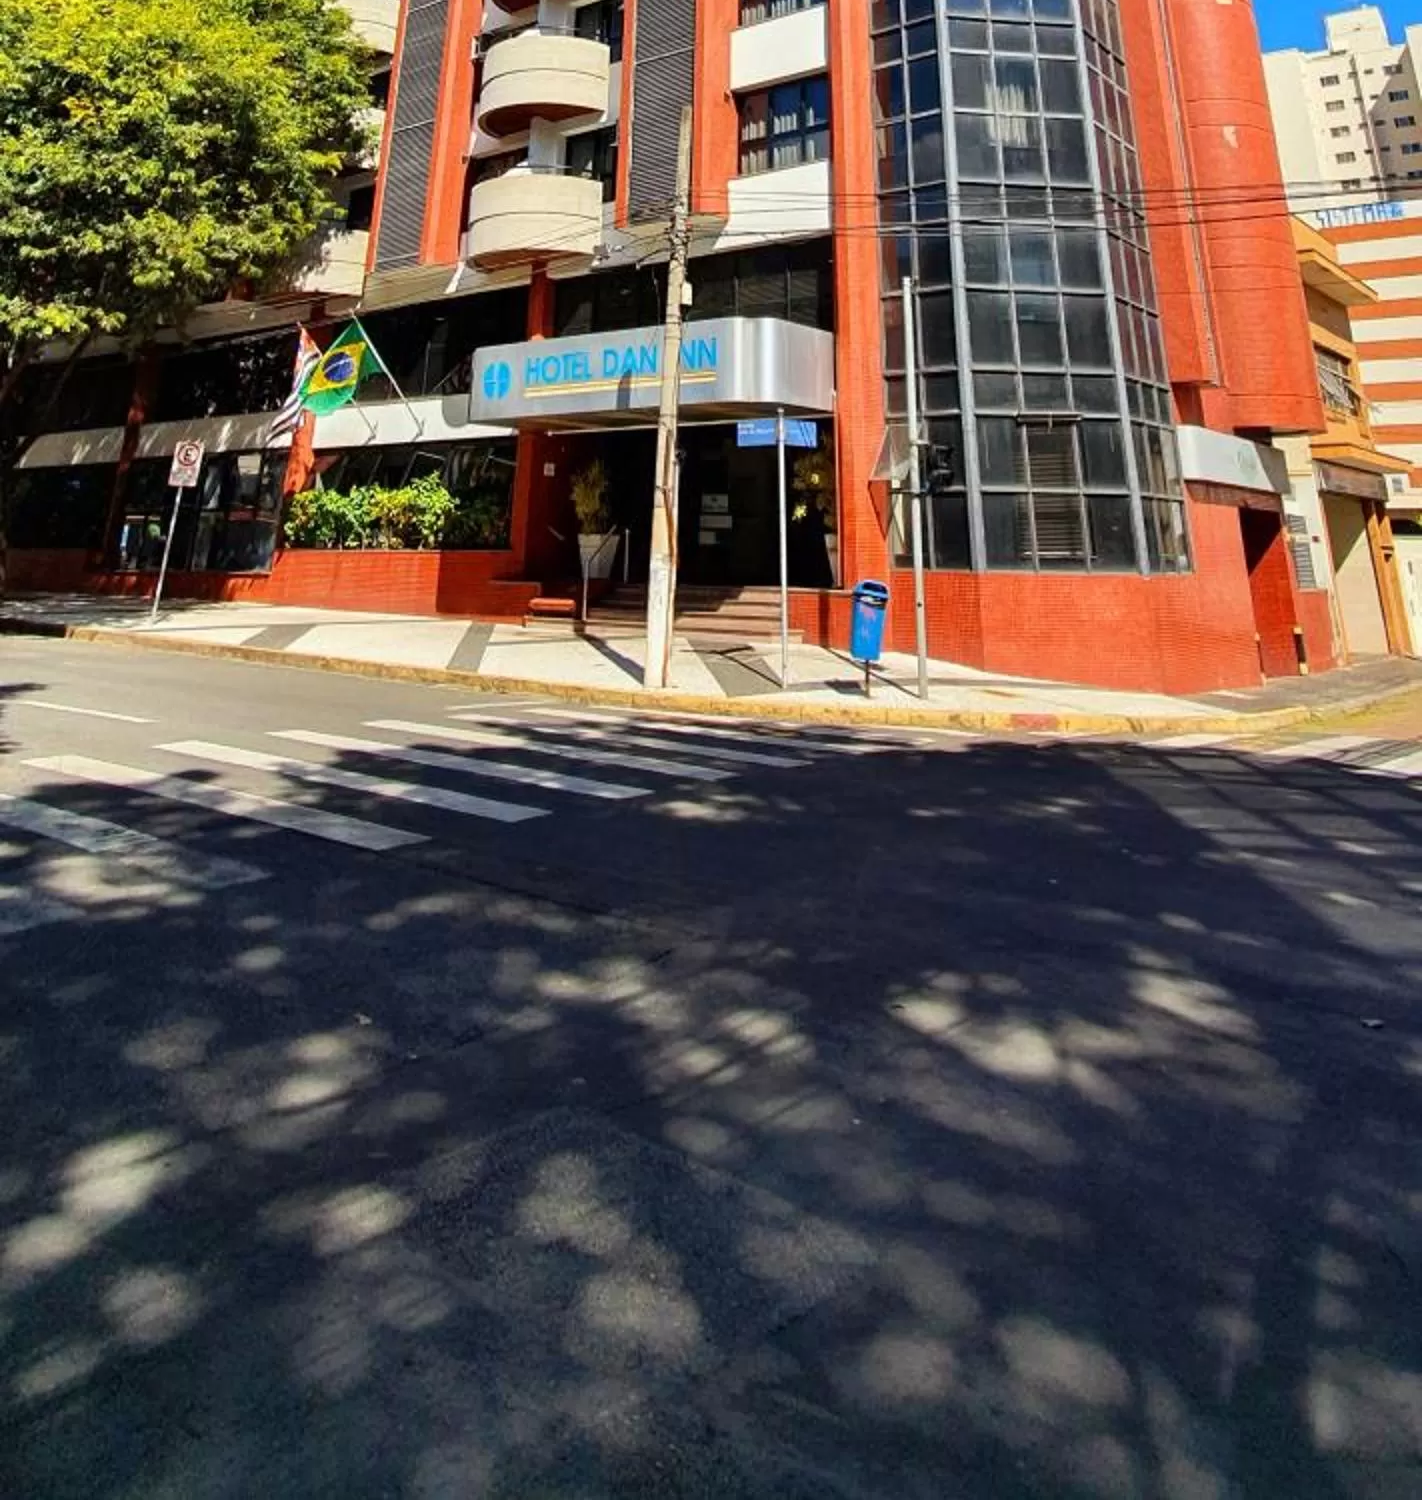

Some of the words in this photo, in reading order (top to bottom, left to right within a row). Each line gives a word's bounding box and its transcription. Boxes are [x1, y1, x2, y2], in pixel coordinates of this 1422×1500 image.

[526, 352, 592, 387] HOTEL
[603, 345, 658, 377] DAN
[678, 337, 717, 369] NN
